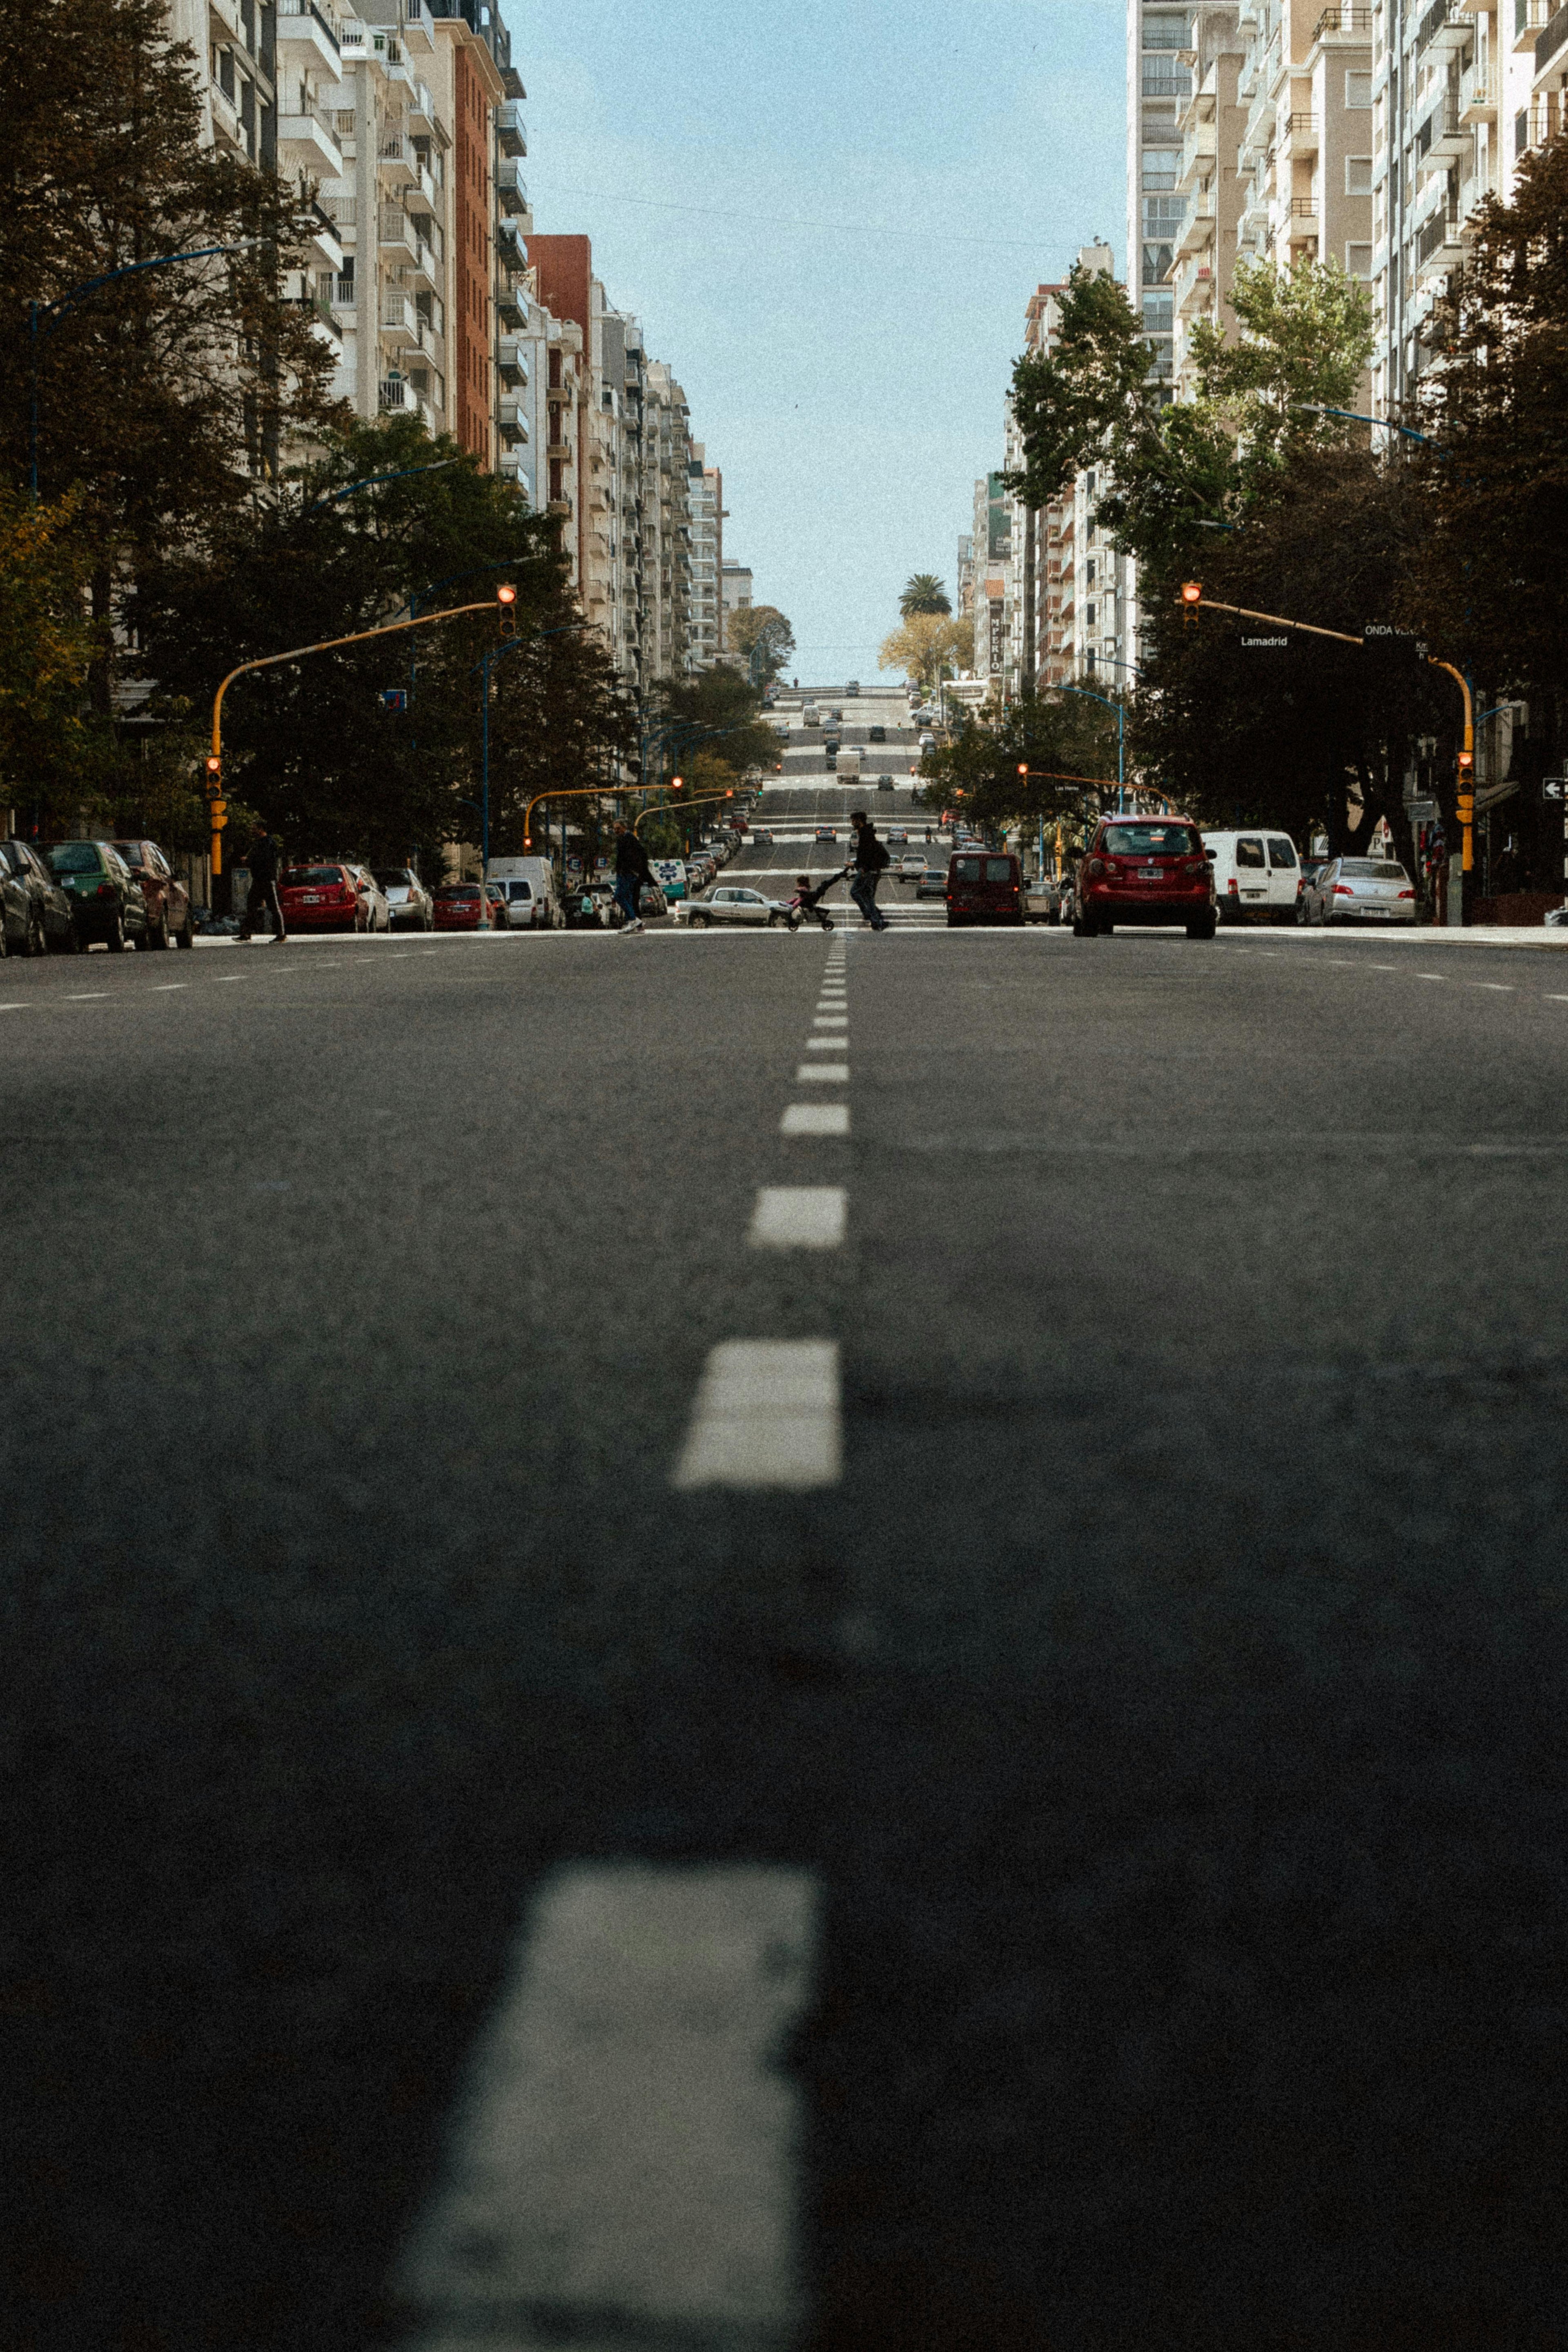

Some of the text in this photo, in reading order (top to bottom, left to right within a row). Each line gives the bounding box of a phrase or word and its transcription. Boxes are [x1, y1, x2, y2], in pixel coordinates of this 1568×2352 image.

[1365, 626, 1393, 635] ONDA
[1241, 637, 1287, 646] Lamadrid
[571, 859, 579, 870] E
[597, 858, 605, 867] E
